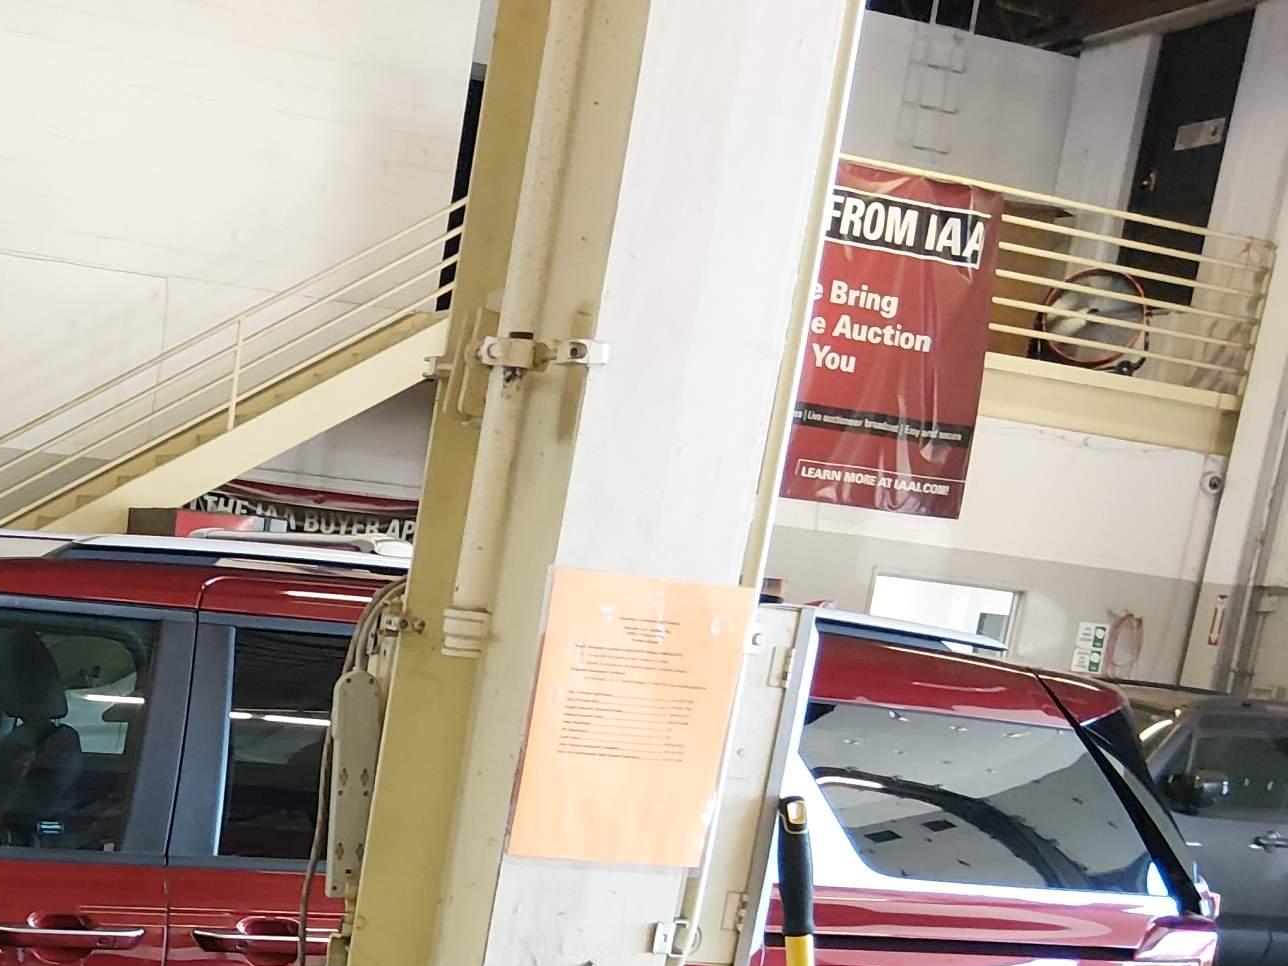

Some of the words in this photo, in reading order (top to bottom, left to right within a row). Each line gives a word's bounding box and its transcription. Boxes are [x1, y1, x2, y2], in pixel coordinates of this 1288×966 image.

[826, 194, 918, 247] FROM
[924, 213, 985, 257] IAA
[829, 280, 899, 318] Bring
[832, 314, 932, 352] Auction
[812, 343, 856, 373] You
[801, 466, 842, 481] LEARN
[843, 472, 876, 486] MORE
[877, 476, 893, 489] AT
